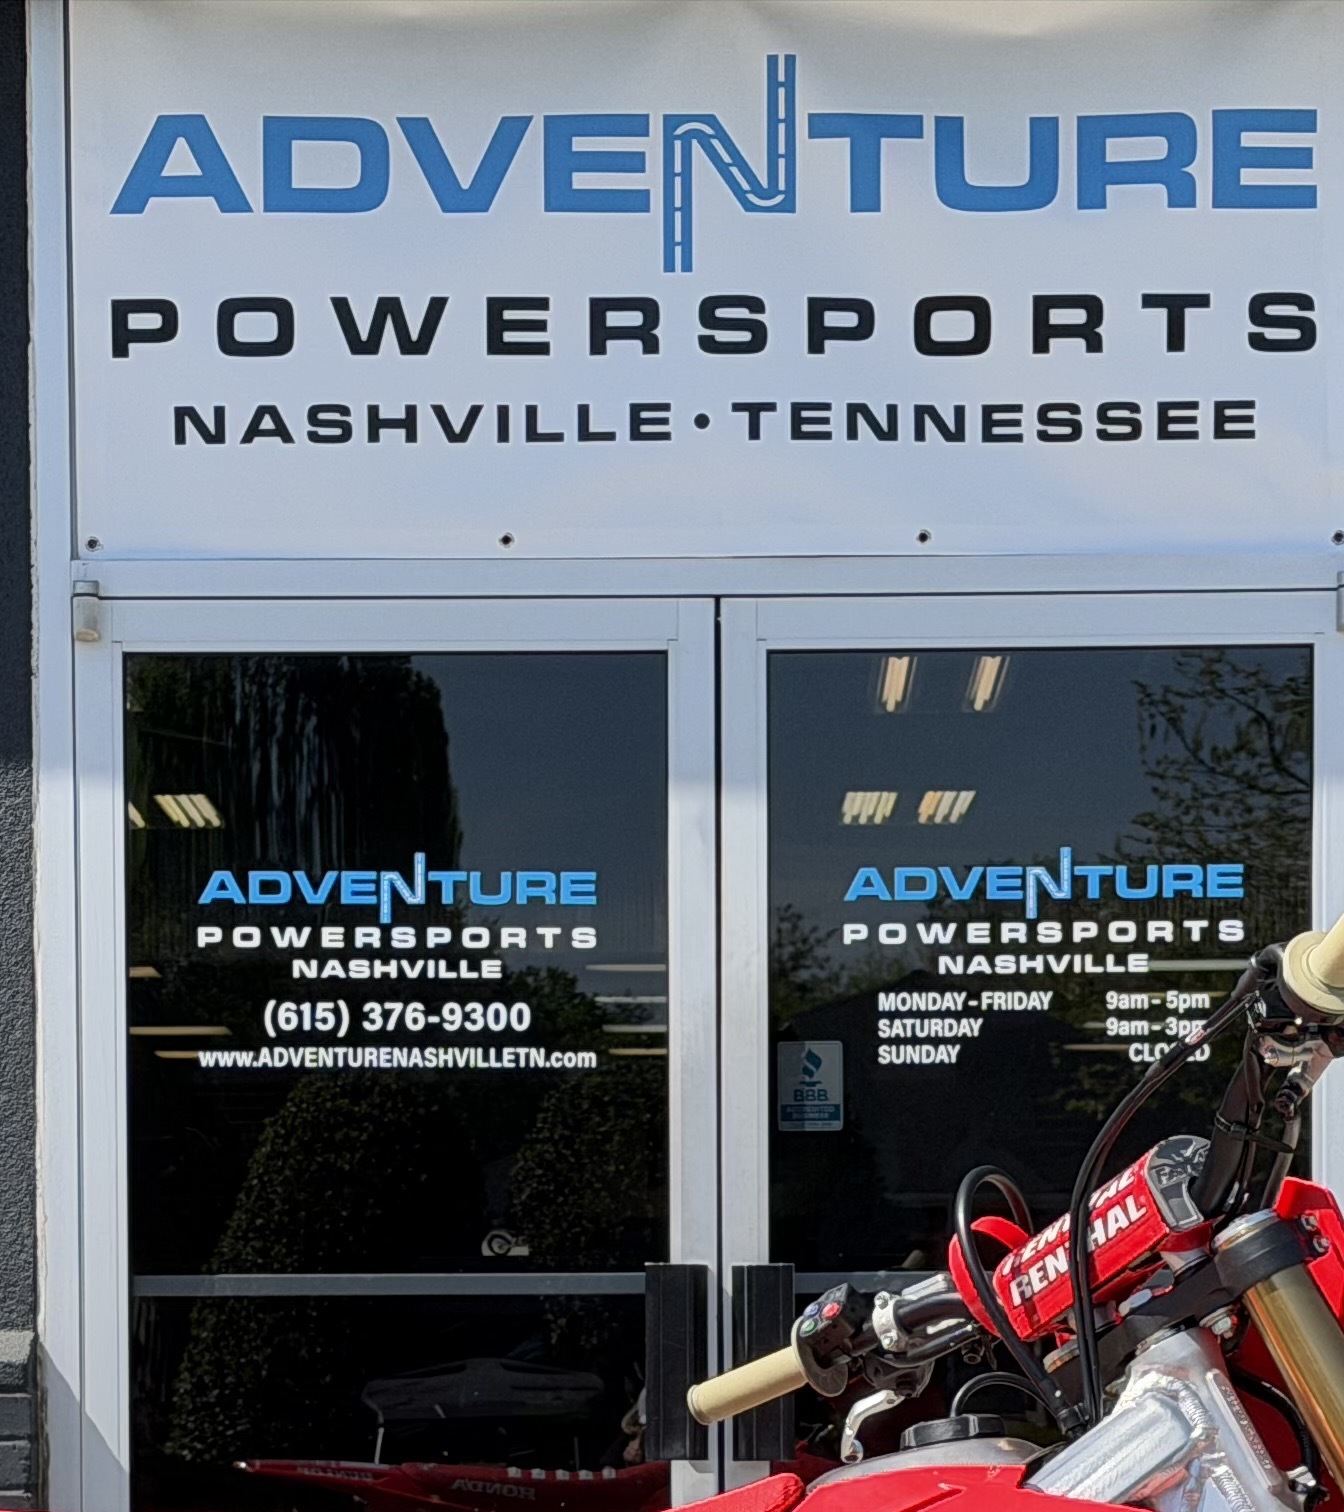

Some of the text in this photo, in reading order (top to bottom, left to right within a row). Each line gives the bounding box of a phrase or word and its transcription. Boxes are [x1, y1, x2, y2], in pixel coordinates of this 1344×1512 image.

[110, 54, 1318, 273] ADVENTURE
[110, 293, 1318, 359] POWERSPORTS
[198, 852, 598, 925] ADVENTURE
[843, 847, 1245, 919] ADVENTURE
[197, 926, 598, 949] POWERSPORTS
[842, 919, 1246, 945] POWERSPORTS
[292, 959, 503, 980] NASHVILLE
[938, 953, 1150, 975] NASHVILLE
[263, 999, 532, 1037] (615) 376-9300
[877, 1017, 984, 1039] SATURDAY
[197, 1046, 598, 1069] www.ADVENTURENASHVILLETN.com
[877, 1044, 961, 1066] SUNDAY
[1128, 1042, 1211, 1063] CLOD
[793, 1088, 829, 1102] BBB
[1009, 1194, 1148, 1308] RENHAL
